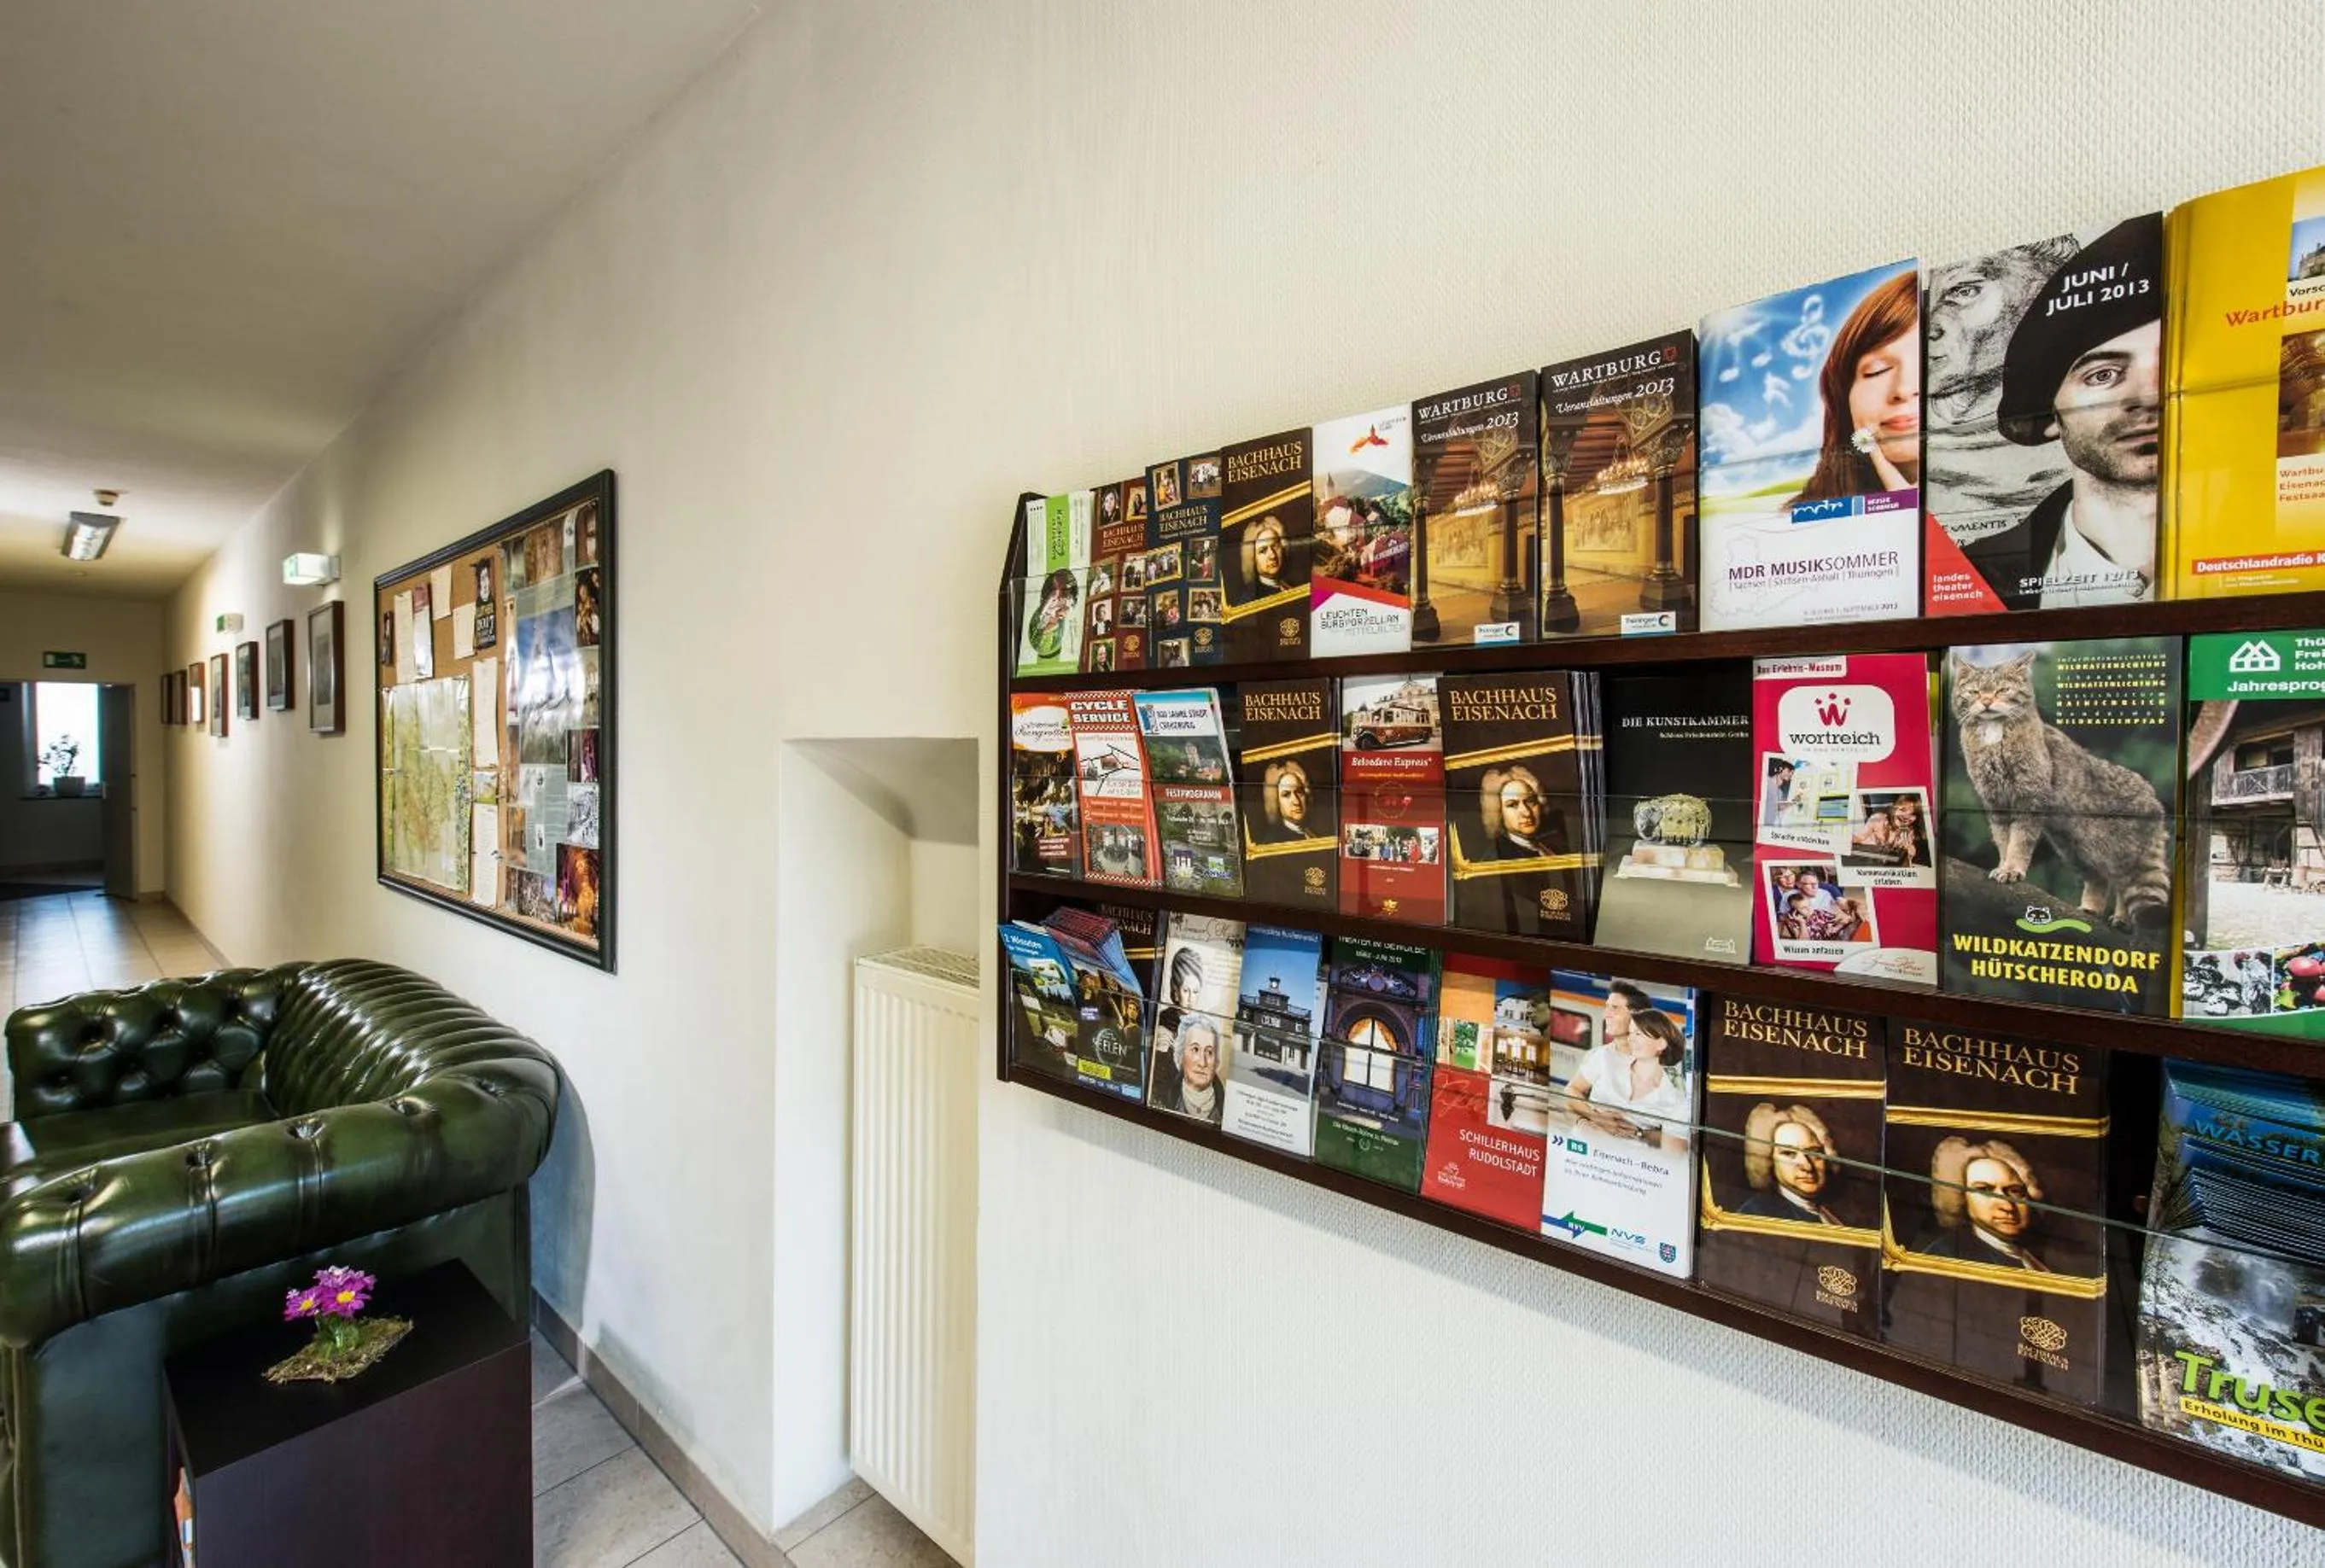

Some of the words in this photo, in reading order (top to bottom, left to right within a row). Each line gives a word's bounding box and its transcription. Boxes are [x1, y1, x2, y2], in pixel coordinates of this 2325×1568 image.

[2060, 265, 2115, 294] JUNI
[2046, 293, 2094, 317] JULI
[2100, 278, 2150, 302] 2013
[1551, 350, 1662, 386] WARTBURG
[1417, 387, 1508, 420] WARTBURG
[1556, 390, 1633, 414] Veranstaltungen
[1635, 377, 1674, 399] 2013
[1487, 411, 1519, 429] 2013
[1227, 440, 1303, 470] BACHHAUS
[1227, 456, 1302, 484] EISENACH
[1159, 504, 1207, 522] BACHHAUS
[1159, 516, 1207, 532] EISENACH
[1103, 533, 1144, 547] EISENACH
[1728, 565, 1765, 580] MDR
[1771, 551, 1898, 576] MUSIKSOMMER
[2197, 553, 2313, 573] Deutschlandradio
[1933, 573, 1971, 583] landes
[1933, 581, 1973, 592] theater
[1933, 589, 1983, 602] eisenach
[1321, 609, 1368, 621] LEUCHTEN
[1070, 699, 1128, 711] CYCLE
[1245, 691, 1322, 708] BACHHAUS
[1450, 687, 1557, 705] BACHHAUS
[1072, 712, 1131, 724] SERVICE
[1246, 706, 1322, 721] EISENACH
[1452, 703, 1559, 721] EISENACH
[1621, 716, 1643, 728] DIE
[1646, 714, 1749, 726] KUNSTKAMMER
[1788, 731, 1880, 745] wortreich
[1953, 933, 2161, 971] WILDKATZENDORF
[1971, 957, 2139, 994] HÜTSCHERODA
[1724, 1000, 1868, 1038] BACHHAUS
[1723, 1018, 1867, 1060] EISENACH
[1904, 1027, 2081, 1074] BACHHAUS
[1903, 1046, 2079, 1096] EISENACH
[1458, 1128, 1540, 1162] SCHILLERHAUS
[2194, 1118, 2320, 1164] WASSER
[1469, 1148, 1537, 1178] RUDOLSTADT
[1592, 1149, 1633, 1167] Eisenach
[1640, 1161, 1669, 1176] Bebra
[2175, 1349, 2325, 1433] Truse
[2184, 1400, 2261, 1433] Erholung
[2265, 1423, 2287, 1438] im
[2291, 1431, 2325, 1449] Thü
